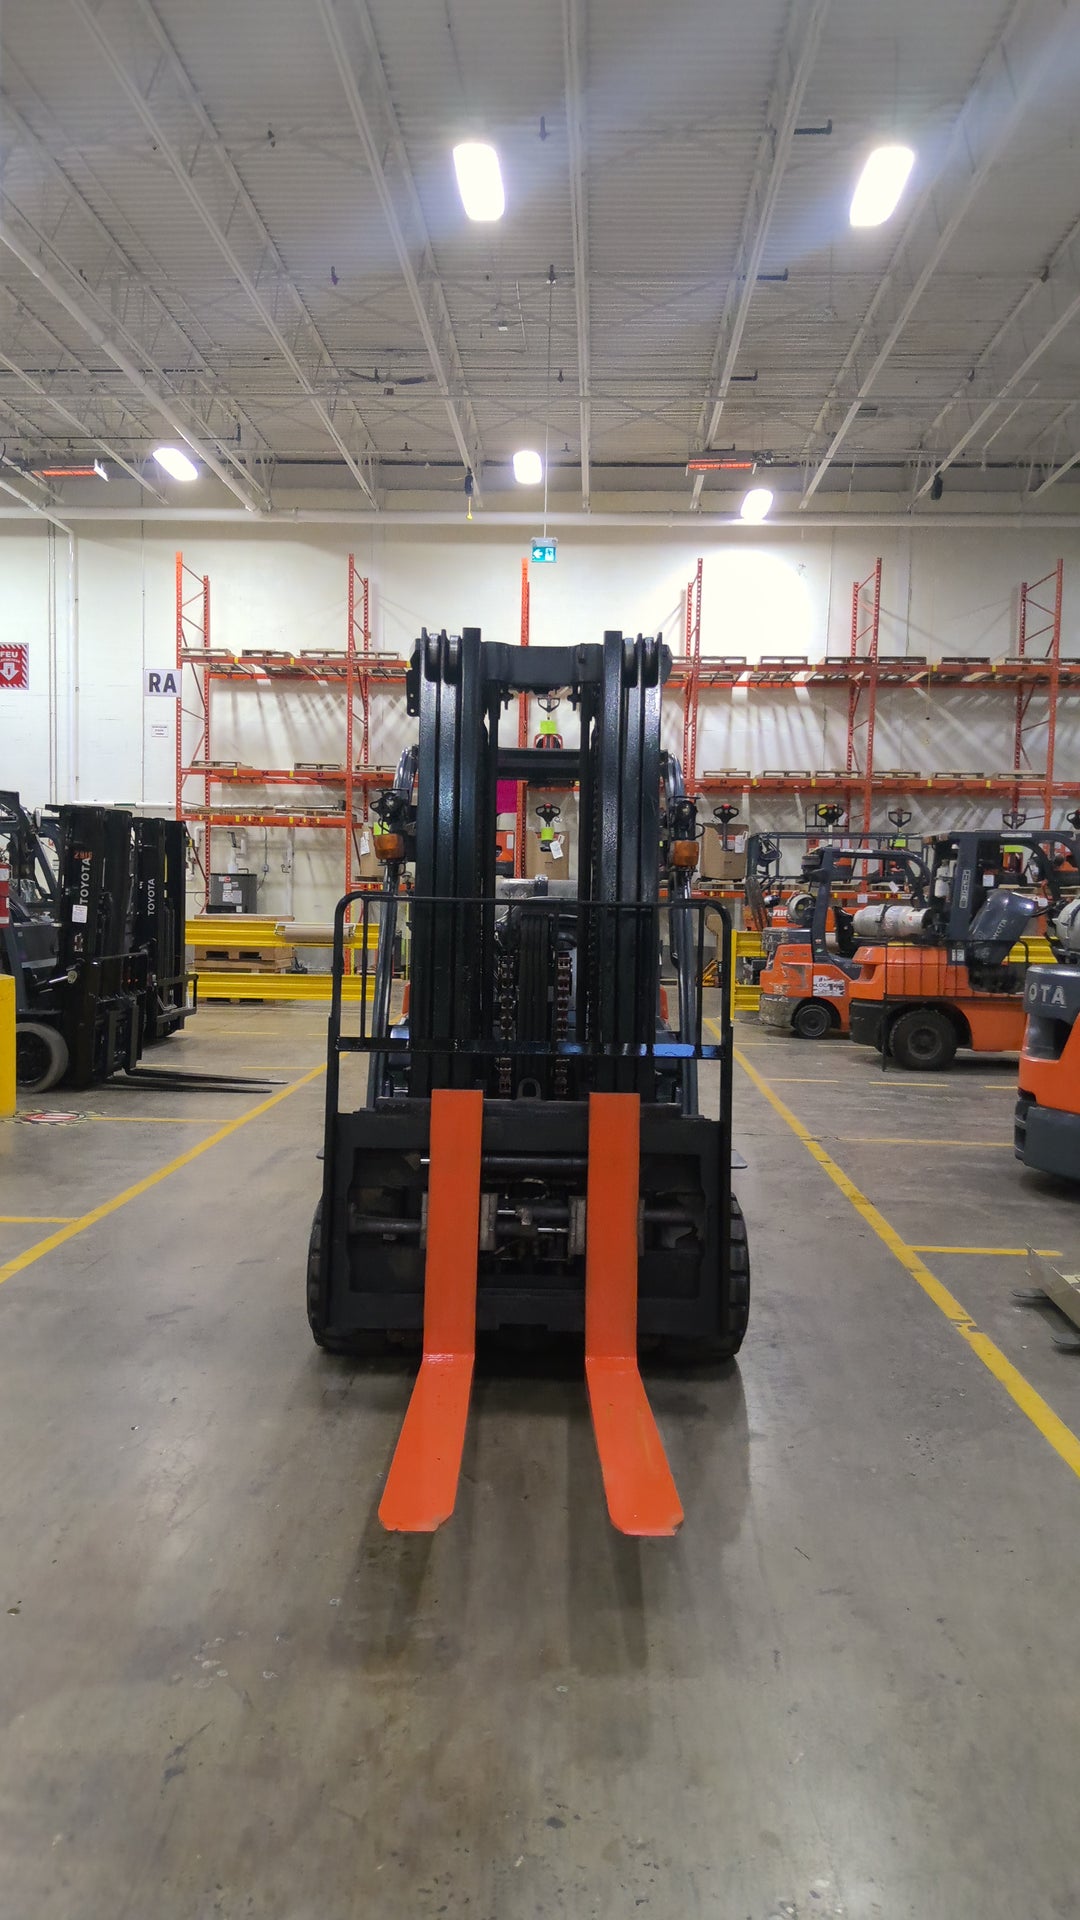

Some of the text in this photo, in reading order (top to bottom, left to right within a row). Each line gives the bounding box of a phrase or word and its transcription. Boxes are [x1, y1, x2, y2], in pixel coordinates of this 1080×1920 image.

[149, 672, 177, 693] RA
[80, 857, 91, 904] TOYOTA
[147, 878, 155, 916] TOYOTA
